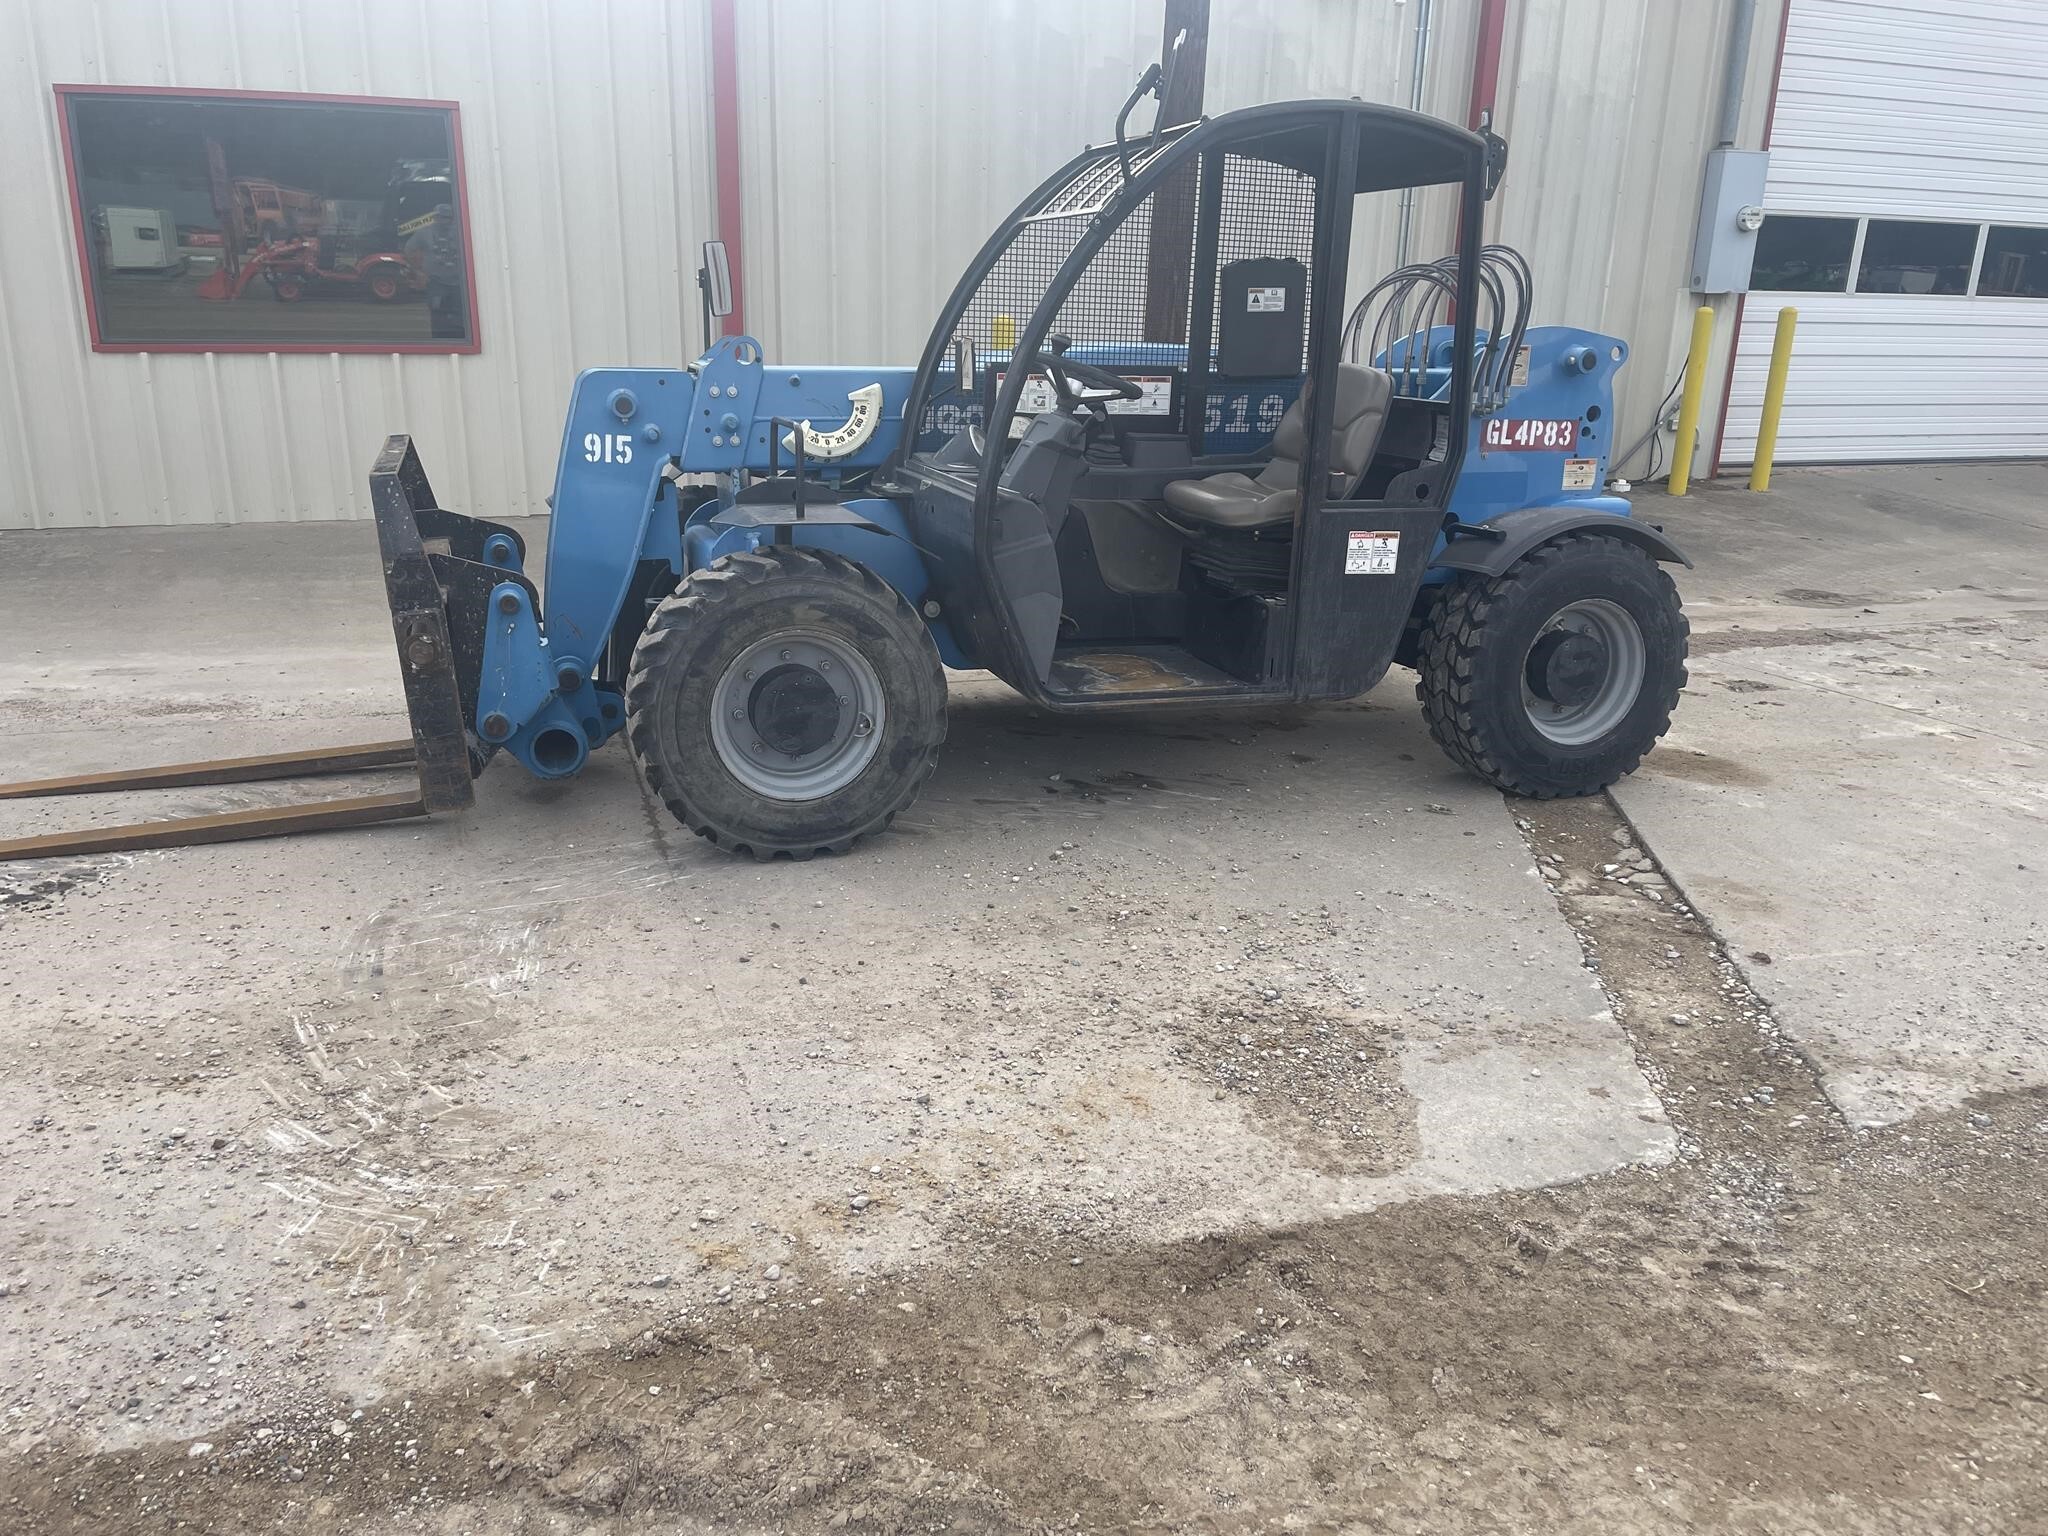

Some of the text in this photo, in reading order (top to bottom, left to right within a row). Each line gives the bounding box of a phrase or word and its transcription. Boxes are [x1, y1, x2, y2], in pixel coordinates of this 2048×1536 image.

[855, 418, 864, 428] 60
[846, 428, 856, 437] 40
[1486, 418, 1572, 447] GL4P83
[835, 435, 846, 444] 20
[584, 433, 633, 464] 915
